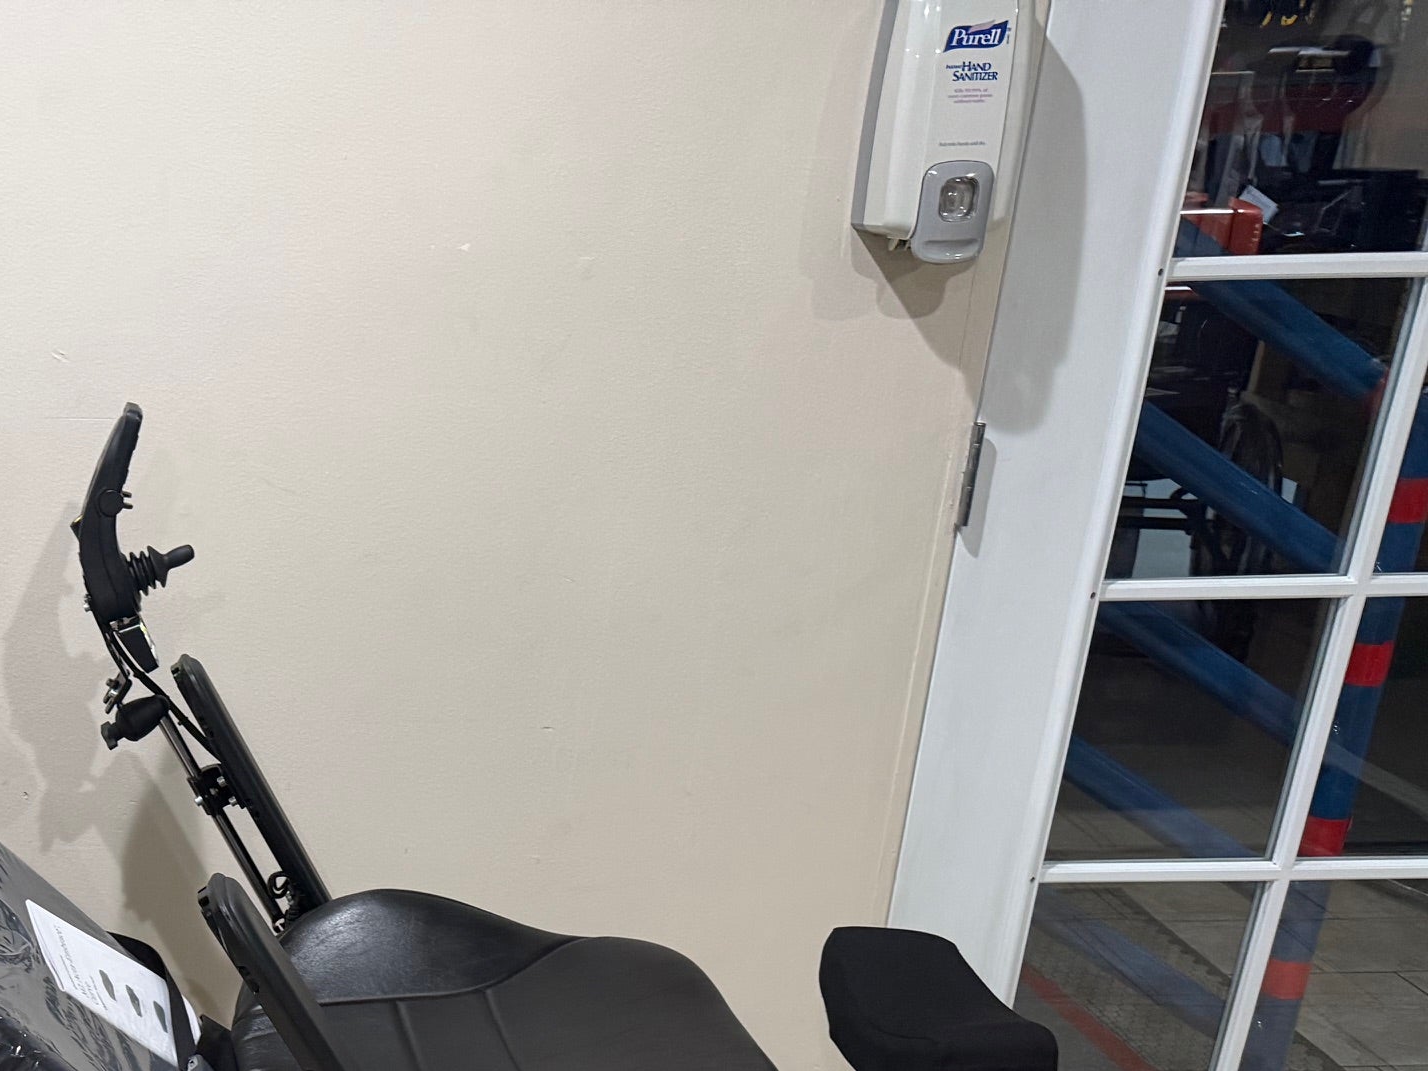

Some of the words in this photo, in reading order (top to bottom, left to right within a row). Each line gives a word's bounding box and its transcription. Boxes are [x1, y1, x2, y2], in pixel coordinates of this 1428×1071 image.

[950, 28, 1002, 46] Purell
[962, 61, 992, 71] HAND
[952, 70, 999, 82] SANITIZER
